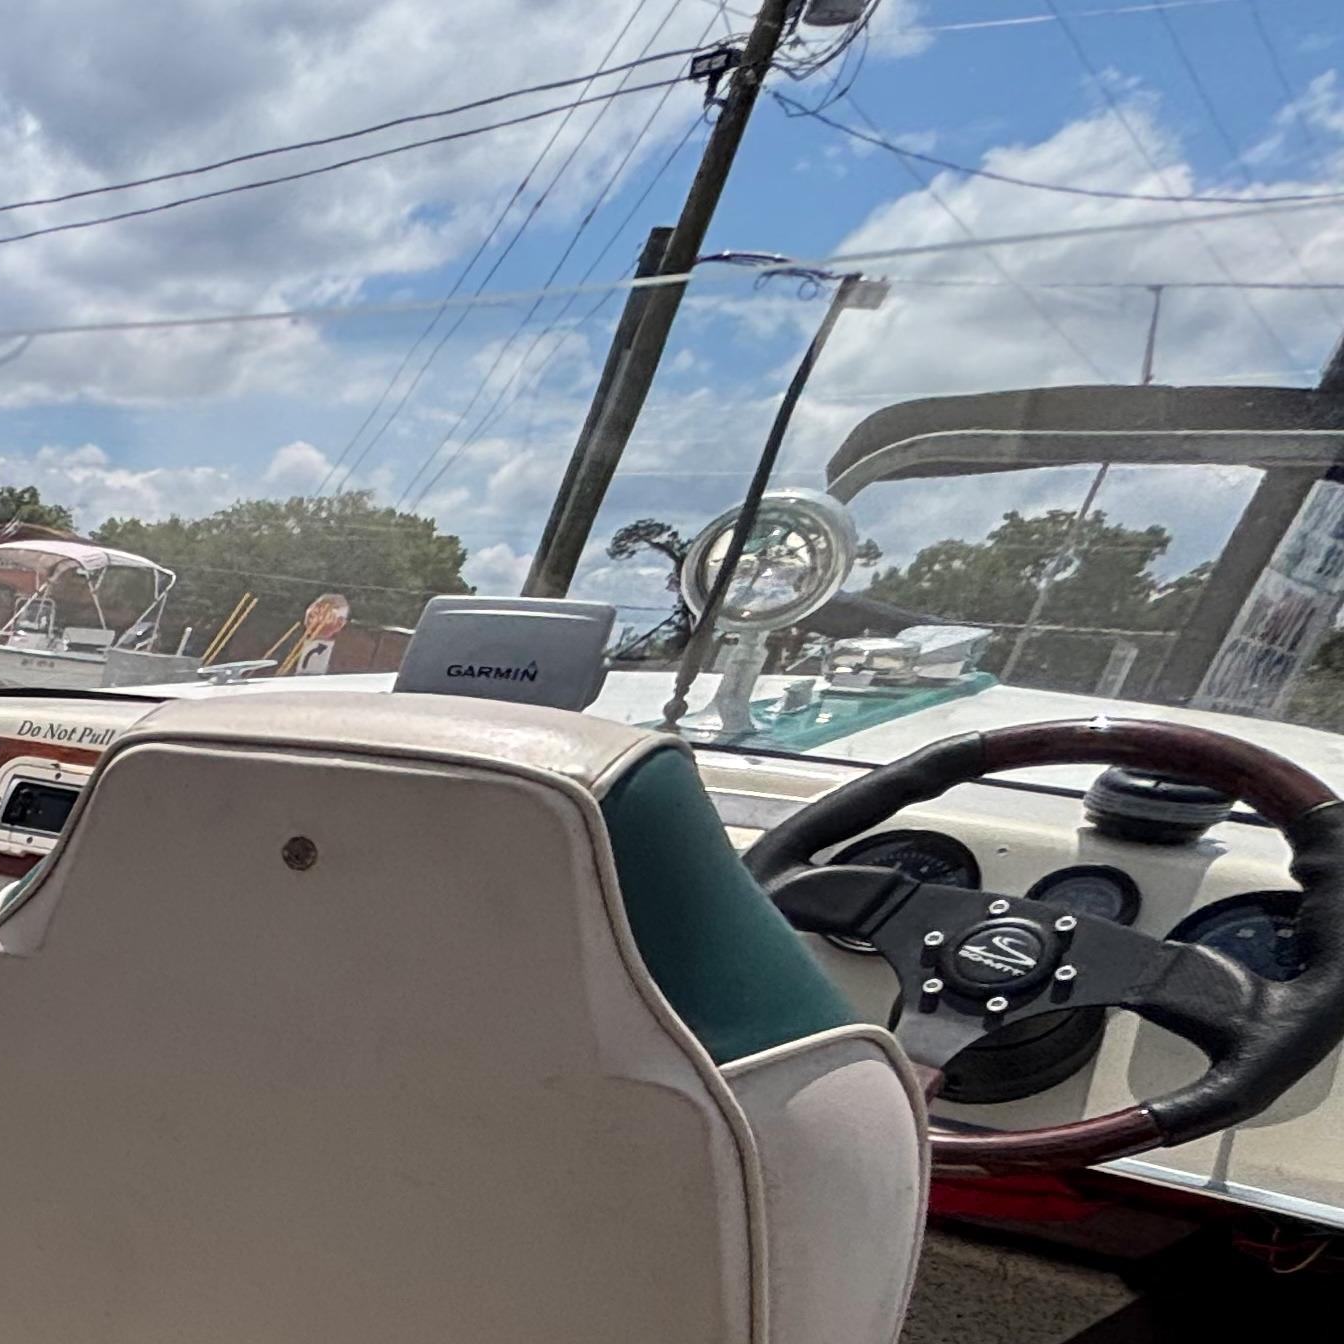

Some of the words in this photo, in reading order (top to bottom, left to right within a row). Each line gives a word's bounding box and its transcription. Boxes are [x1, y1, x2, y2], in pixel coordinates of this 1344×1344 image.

[447, 663, 538, 682] GARMIN
[17, 720, 42, 737] Do
[42, 723, 78, 741] Not
[77, 727, 116, 746] Pull
